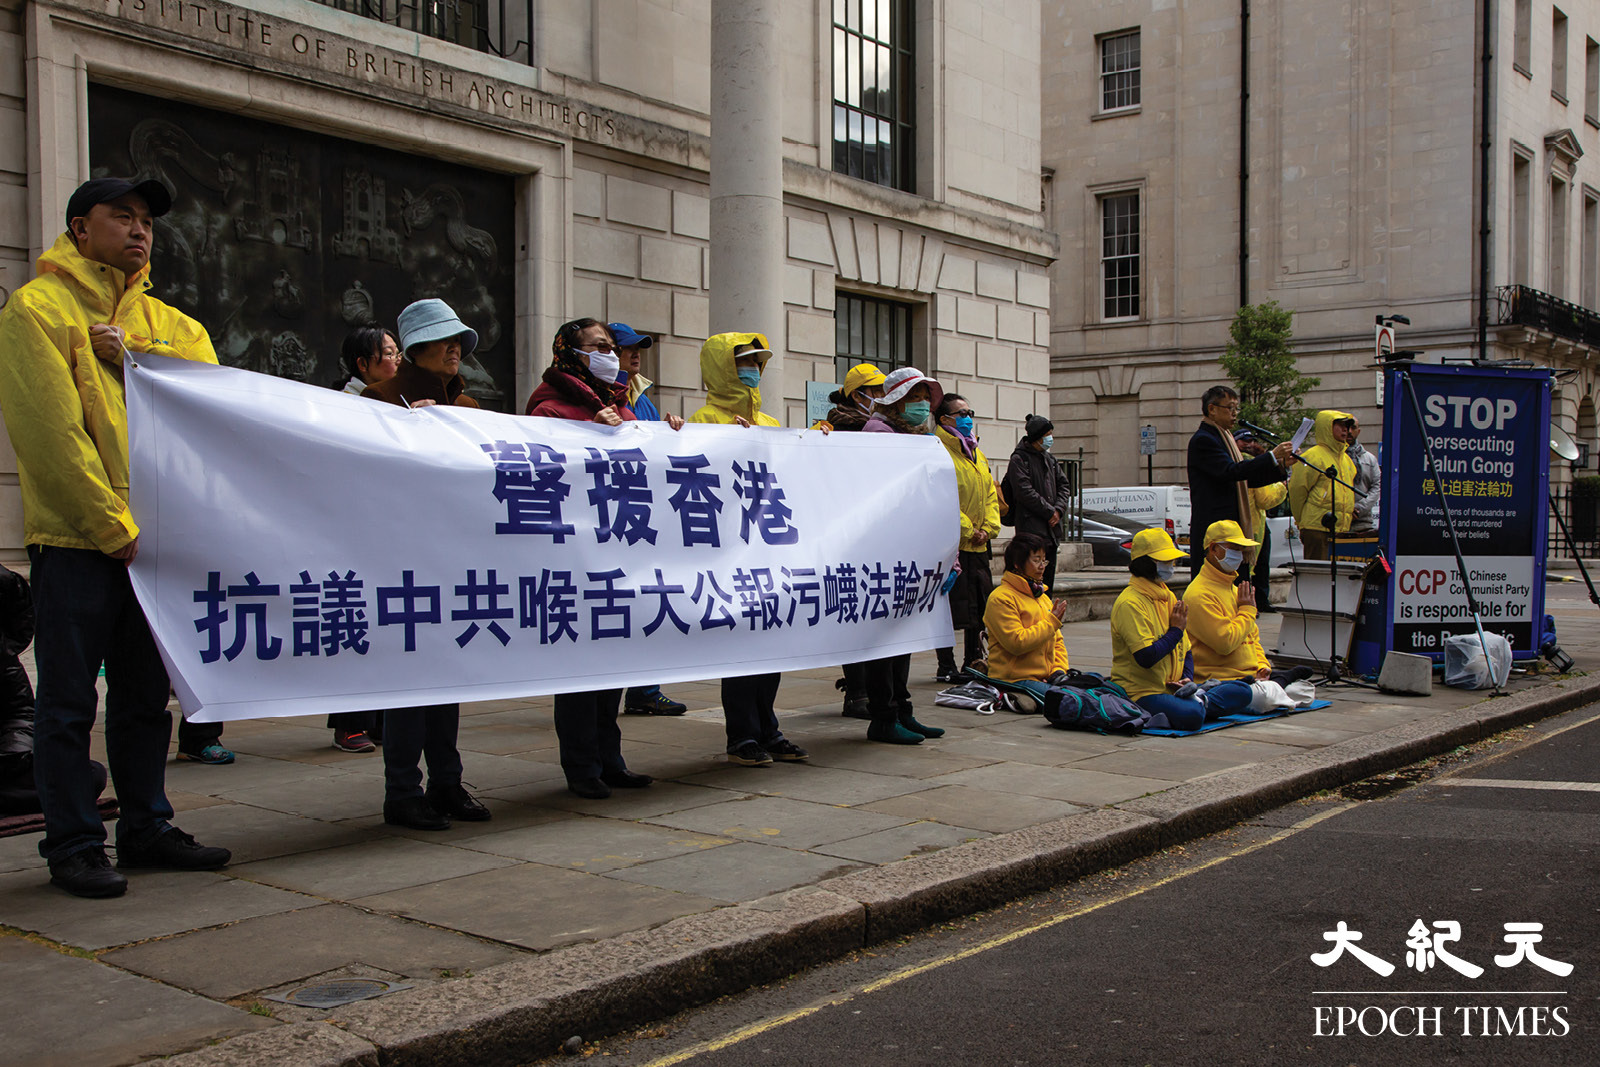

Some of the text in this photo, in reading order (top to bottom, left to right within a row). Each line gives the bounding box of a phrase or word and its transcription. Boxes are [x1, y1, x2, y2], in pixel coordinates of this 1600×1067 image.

[292, 33, 326, 59] OF
[346, 47, 454, 94] BRITISH
[468, 81, 615, 136] ARCHITECTS
[1424, 394, 1518, 431] STOP
[1471, 456, 1514, 478] Gong
[480, 439, 799, 548] 聲援香港
[1416, 506, 1424, 515] In
[1463, 508, 1470, 517] of
[1471, 508, 1504, 517] thousands
[1430, 518, 1503, 528] tortud and murdered
[1468, 530, 1490, 539] beliefs
[1399, 569, 1447, 596] CCP
[1450, 570, 1507, 581] Th Chinese
[1505, 584, 1530, 597] Party
[1400, 602, 1413, 618] is
[1505, 601, 1527, 617] for
[1411, 630, 1436, 647] the
